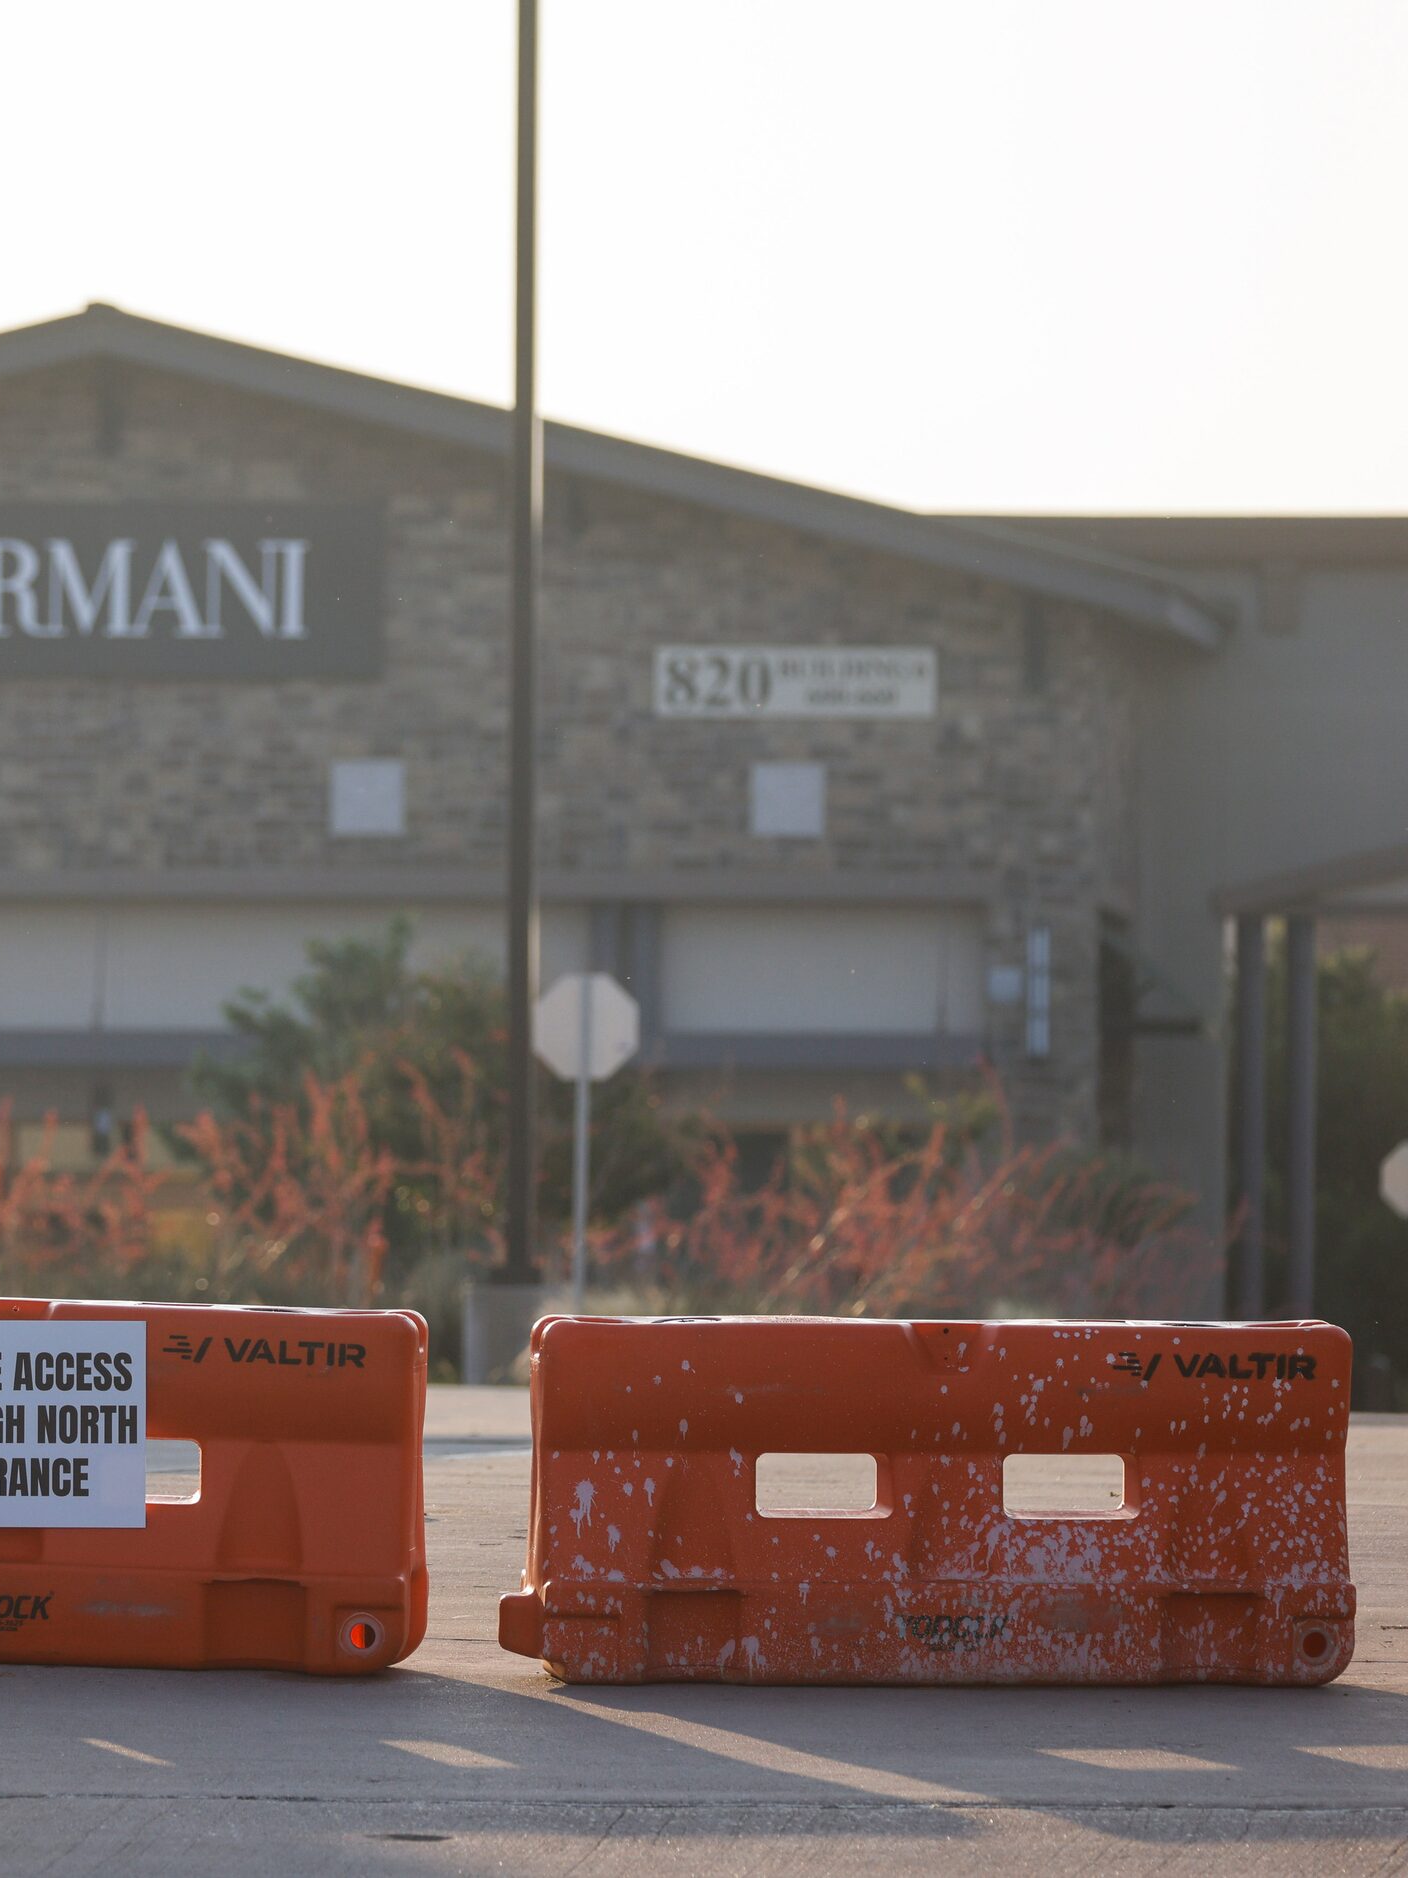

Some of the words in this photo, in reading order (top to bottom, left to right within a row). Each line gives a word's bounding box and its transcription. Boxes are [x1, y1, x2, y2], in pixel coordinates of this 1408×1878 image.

[665, 656, 772, 706] 820
[13, 1352, 133, 1391] ACCESS
[224, 1337, 367, 1369] VALTIR
[1173, 1352, 1318, 1380] VALTIR
[37, 1405, 138, 1444] NORTH
